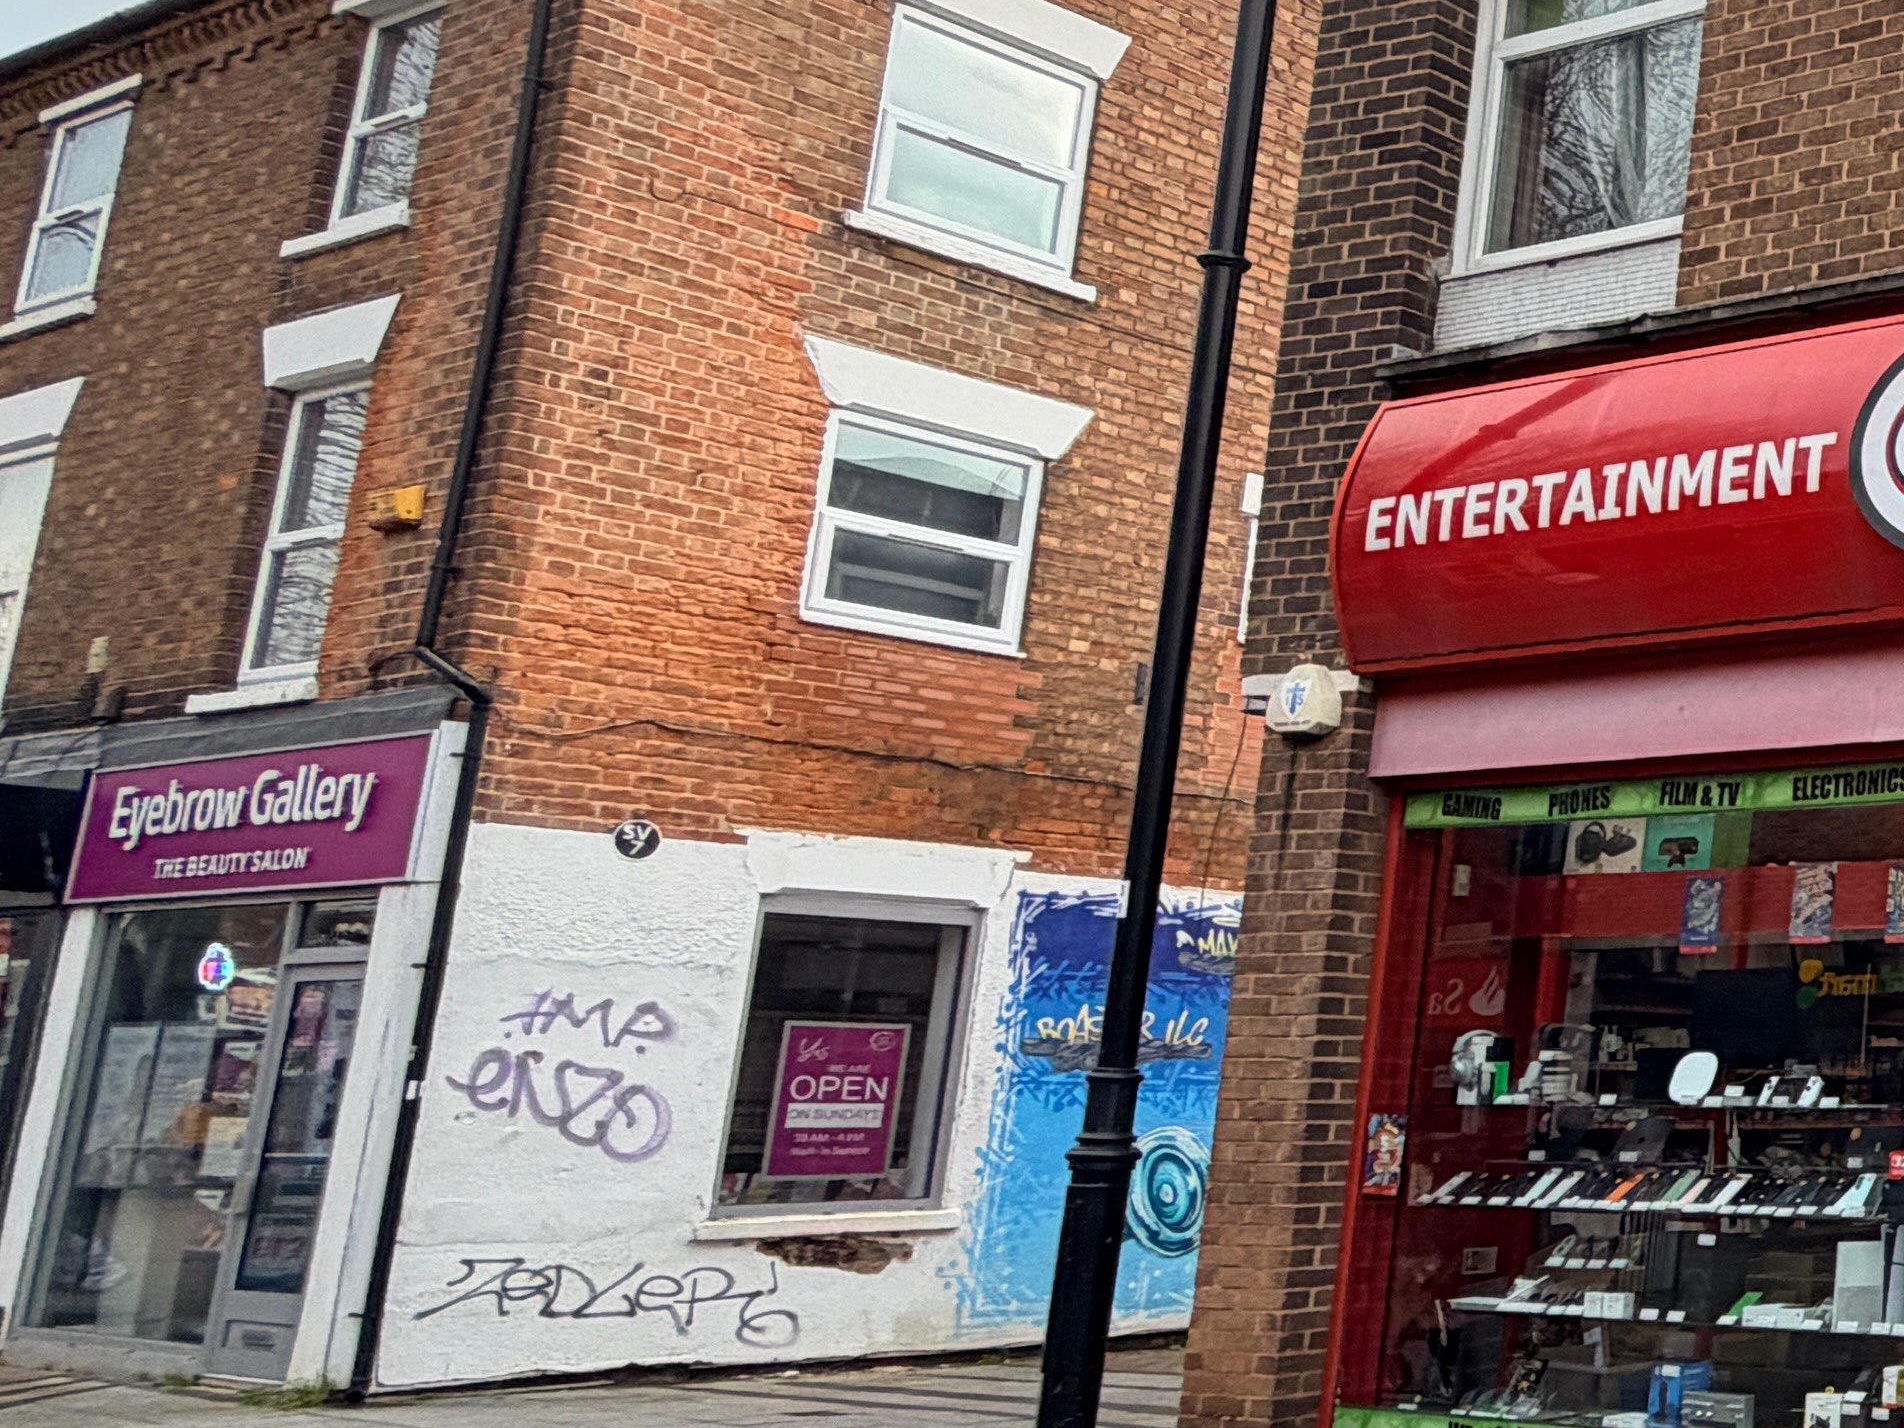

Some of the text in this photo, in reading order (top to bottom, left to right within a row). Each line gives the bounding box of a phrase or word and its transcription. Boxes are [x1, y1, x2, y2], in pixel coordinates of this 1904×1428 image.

[1364, 432, 1839, 552] ENTERTAINMENT
[108, 763, 378, 851] Eyebrow Gallery
[1441, 792, 1502, 821] GAMING
[1547, 785, 1611, 817] PHONES
[1659, 781, 1697, 806] FILM
[1701, 785, 1712, 806] &
[1717, 781, 1742, 806] TV
[621, 822, 653, 841] SV
[153, 847, 309, 879] THE BEAUTY SALON
[789, 1074, 889, 1101] OPEN
